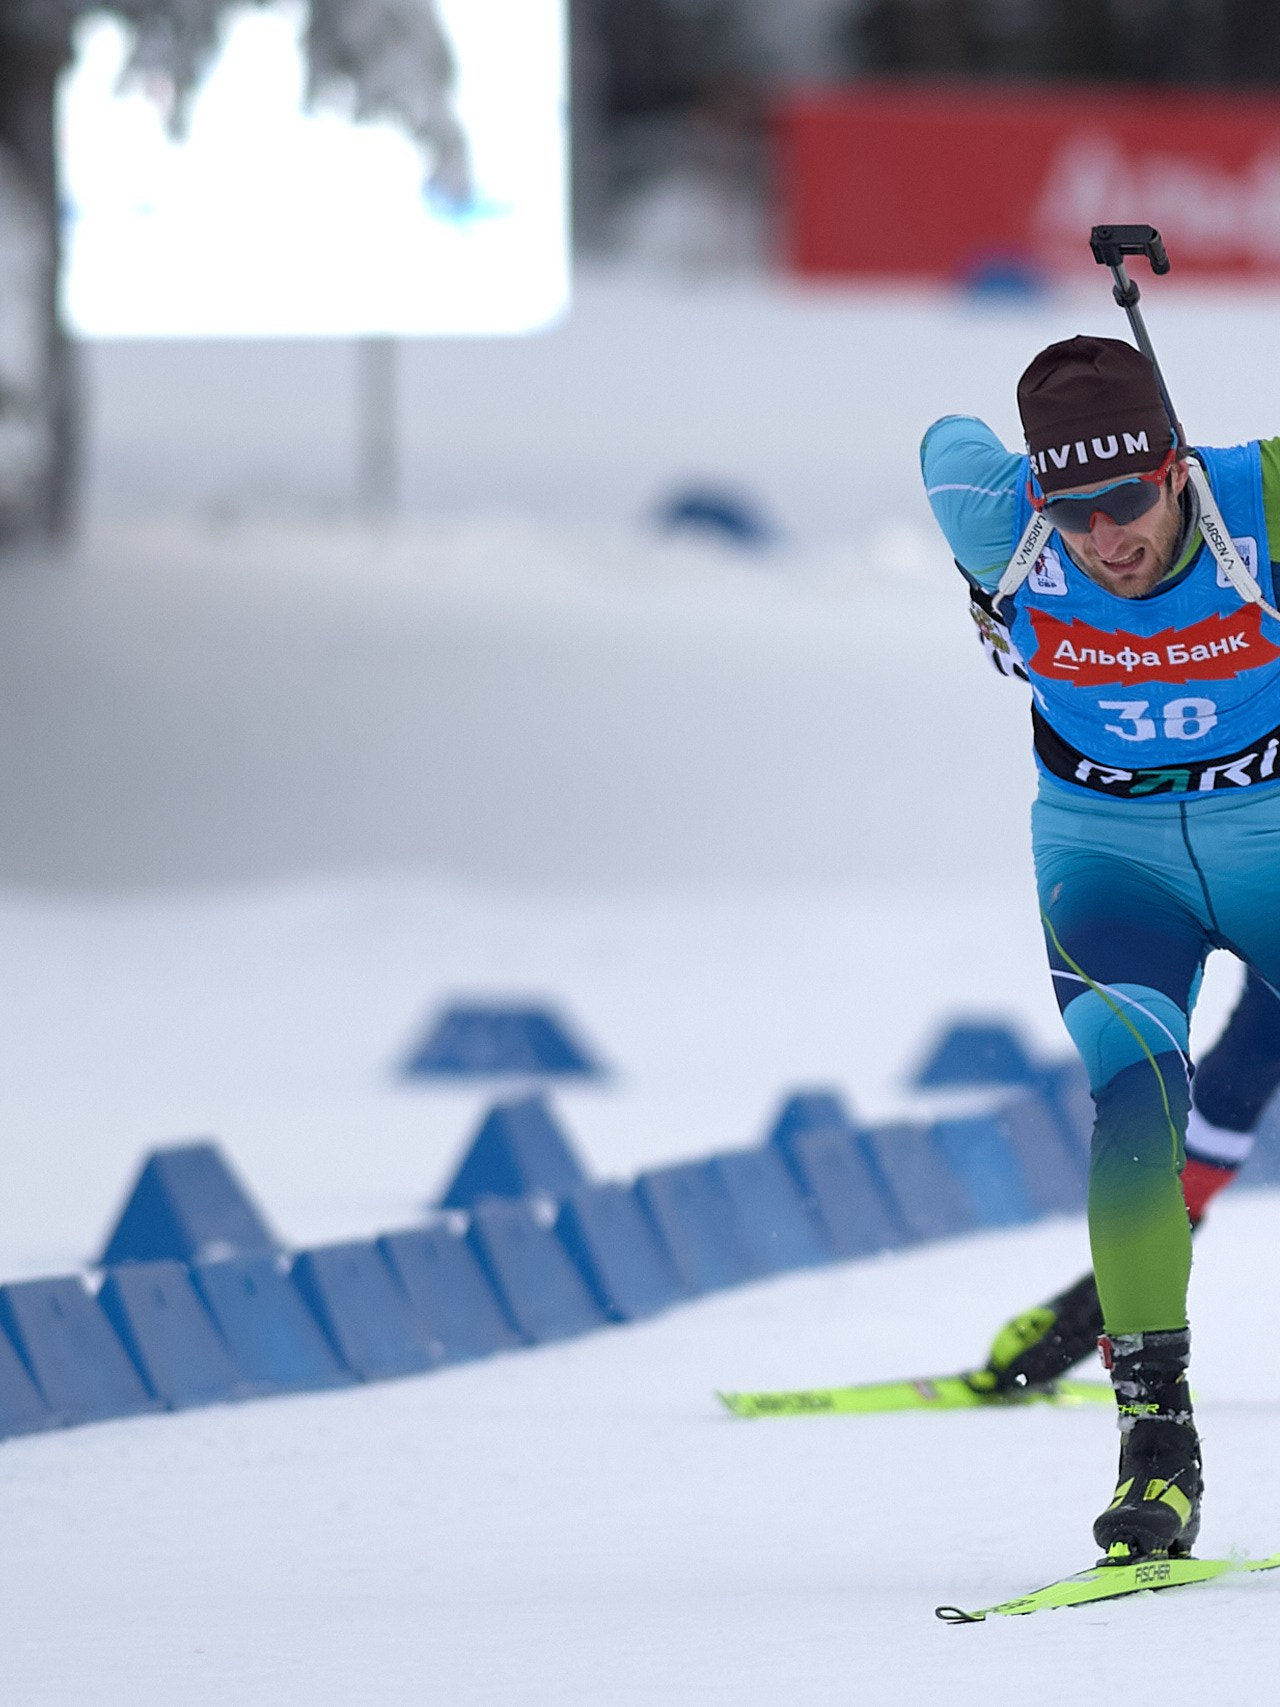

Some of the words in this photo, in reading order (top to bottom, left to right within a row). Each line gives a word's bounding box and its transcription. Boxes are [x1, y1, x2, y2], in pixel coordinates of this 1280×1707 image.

[1023, 514, 1047, 556] LARSEN
[1201, 514, 1230, 557] LARSEN
[1053, 639, 1162, 672] Альфа
[1166, 631, 1251, 665] Банк
[1098, 696, 1218, 742] 38
[1135, 1563, 1171, 1584] FISCHER
